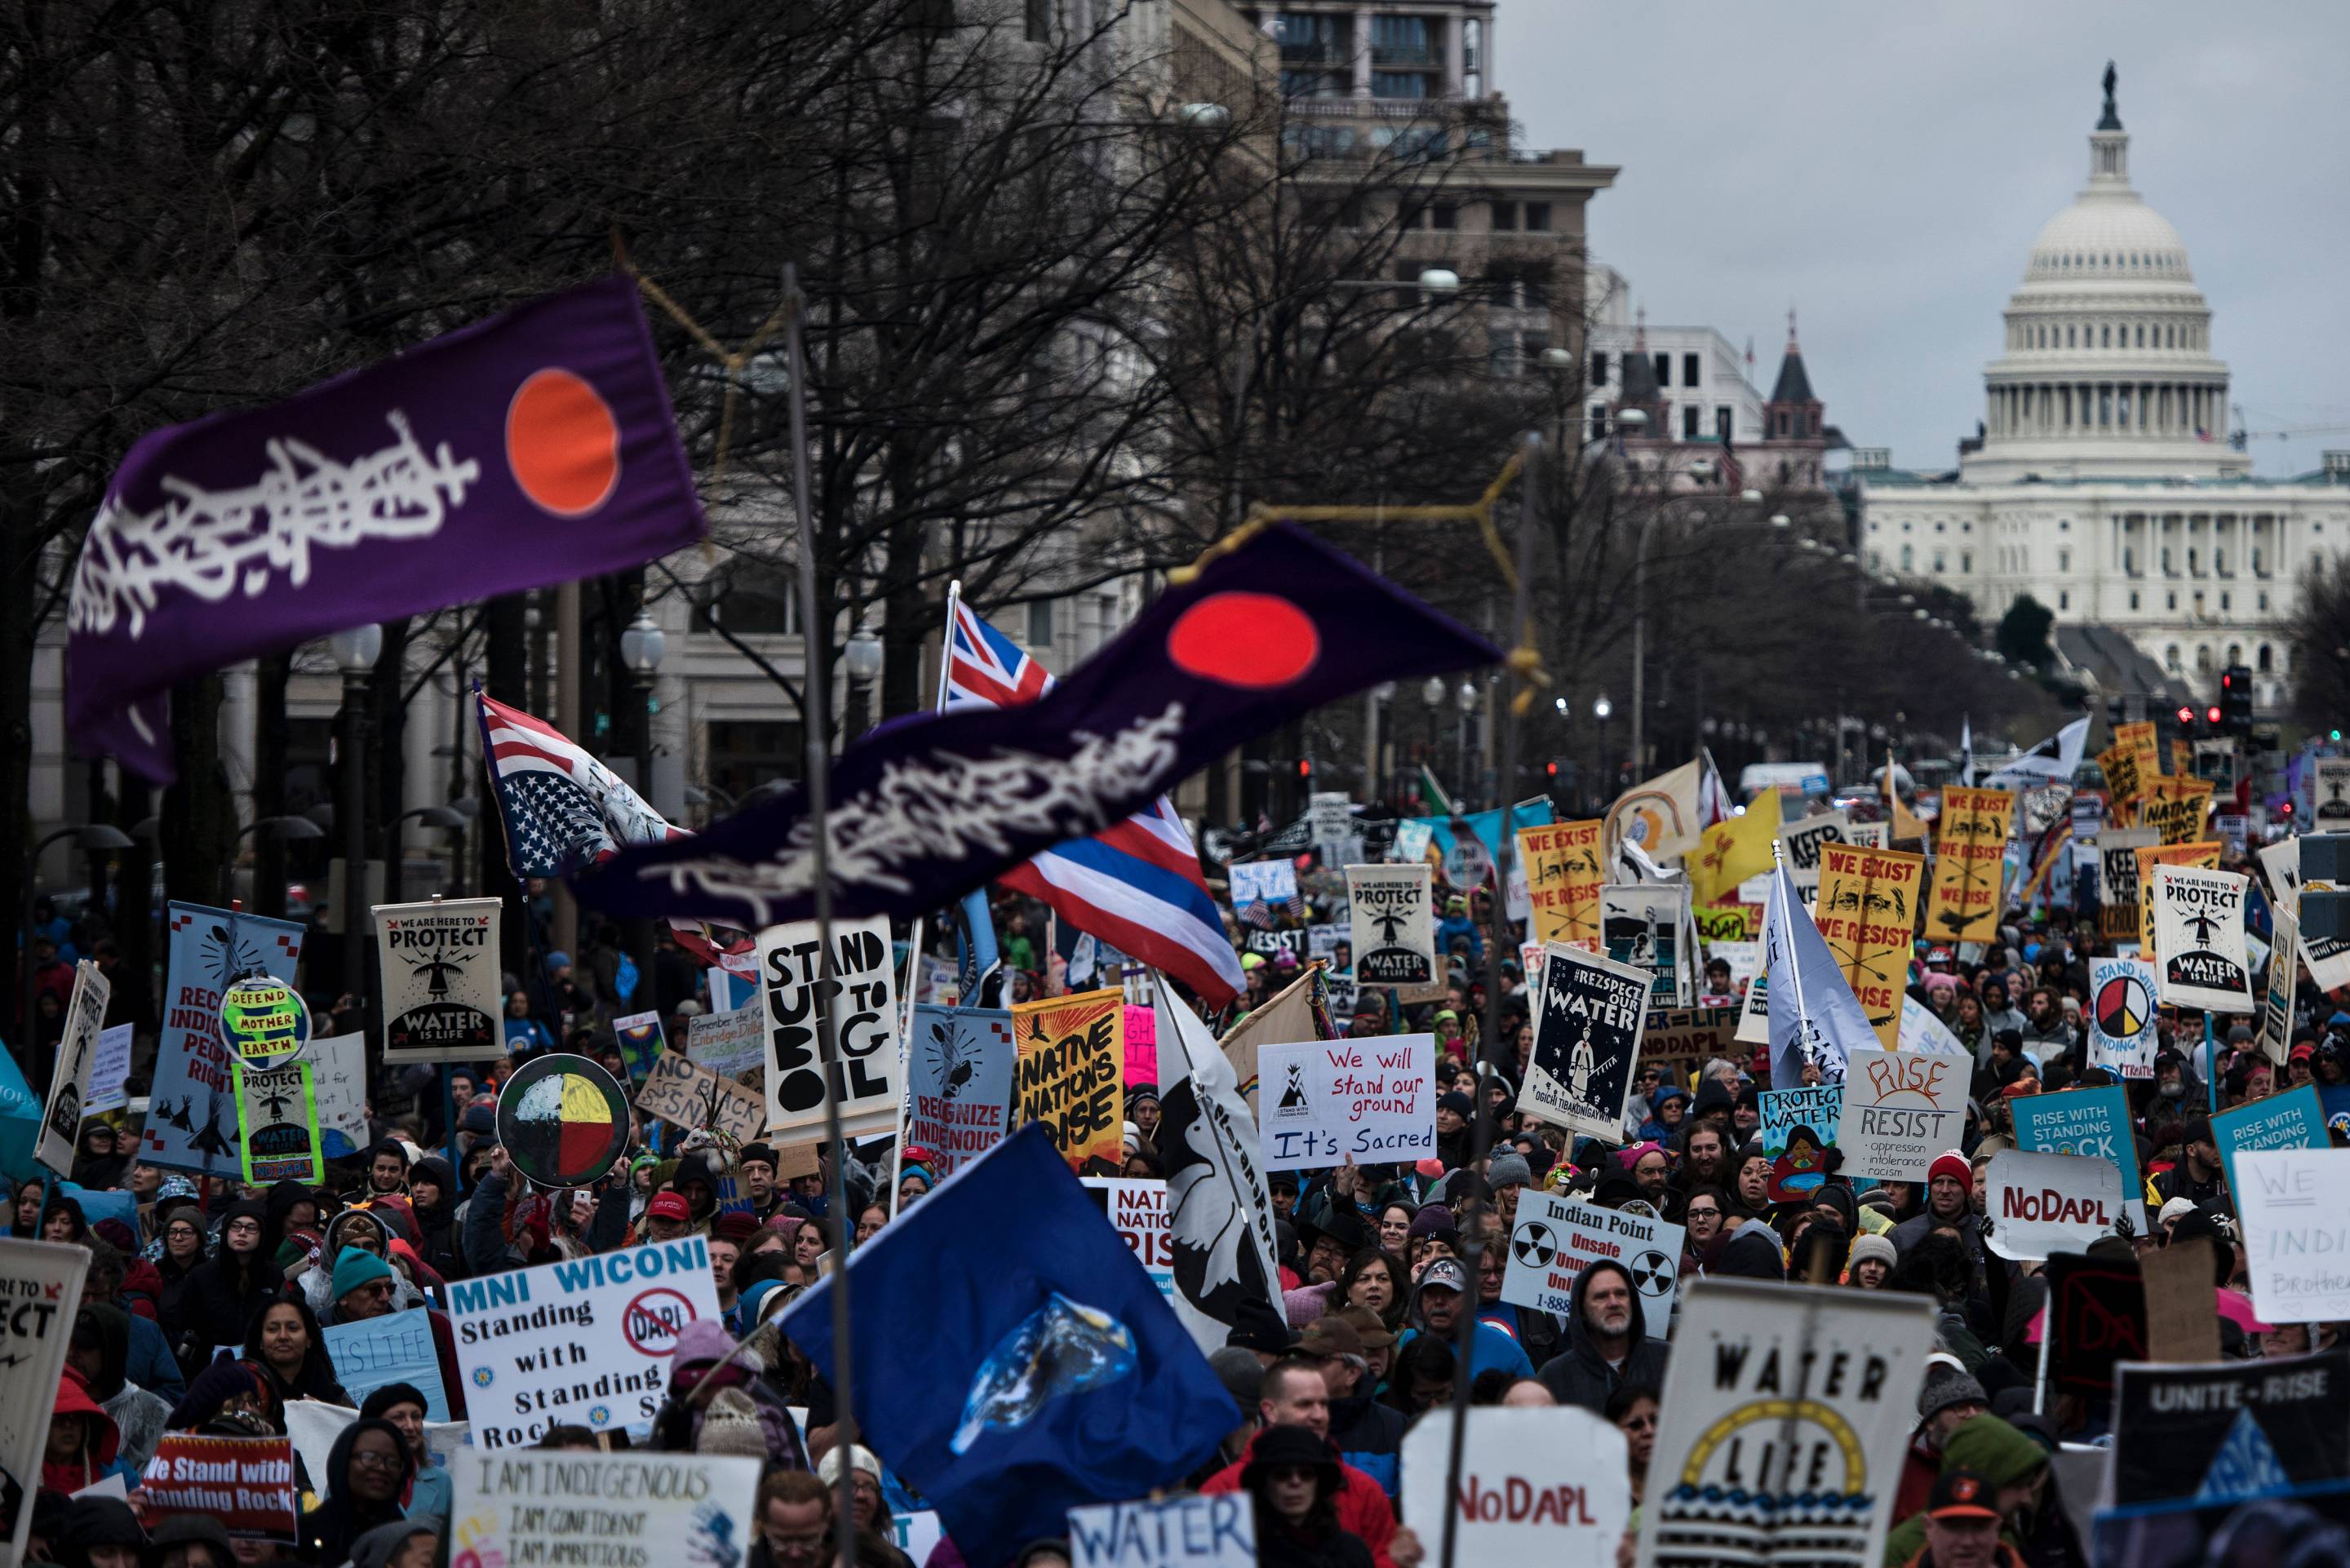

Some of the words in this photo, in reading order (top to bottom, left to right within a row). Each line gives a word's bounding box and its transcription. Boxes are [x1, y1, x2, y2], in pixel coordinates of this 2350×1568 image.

[1948, 795, 1967, 809] WE
[1971, 796, 2009, 811] EXIST
[1526, 834, 1550, 853] WE
[1554, 828, 1598, 849] EXIST
[1939, 841, 1958, 856] WE
[1962, 844, 2004, 860] RESIST
[1829, 851, 1857, 875] WE
[1860, 857, 1915, 882] EXIST
[2104, 848, 2139, 875] KEE
[1355, 890, 1421, 904] PROTECT
[1530, 889, 1555, 908] WE
[1558, 882, 1606, 905] RESIS
[1941, 888, 1961, 902] WE
[1964, 890, 1991, 904] RISE
[2166, 885, 2238, 908] PROTECT
[2202, 880, 2218, 889] HERE
[401, 919, 414, 928] WE
[417, 918, 434, 927] ARE
[437, 918, 459, 926] HERE
[463, 917, 475, 925] TO
[1816, 917, 1843, 938] WE
[1847, 922, 1912, 947] RESIST
[389, 927, 488, 948] PROTECT
[767, 930, 885, 990] STAND
[1366, 955, 1422, 970] WATER
[2177, 956, 2238, 978] WATER
[1379, 969, 1386, 977] IS
[1390, 969, 1410, 977] LIFE
[1574, 969, 1642, 999] #REZSPECT
[2095, 962, 2135, 986] STAND
[2139, 968, 2158, 999] WITH
[2191, 972, 2201, 982] IS
[2204, 972, 2224, 985] LIFE
[233, 991, 285, 1003] DEFEND
[769, 980, 844, 1025] UP
[849, 981, 887, 1012] TO
[1548, 986, 1636, 1032] WATER
[1609, 994, 1638, 1012] OUR
[241, 1015, 292, 1029] MOTHER
[402, 1012, 484, 1031] WATER
[734, 1012, 748, 1024] the
[420, 1030, 431, 1039] IS
[437, 1030, 463, 1039] LIFE
[774, 1012, 889, 1071] BIG
[244, 1040, 290, 1055] EARTH
[1022, 1013, 1115, 1091] NATIVE
[1327, 1047, 1363, 1068] We
[243, 1072, 303, 1088] PROTECT
[332, 1072, 349, 1084] for
[657, 1056, 694, 1079] NO
[1867, 1056, 1949, 1096] RISE
[778, 1058, 888, 1112] OIL
[1023, 1052, 1116, 1123] NATIONS
[1332, 1074, 1383, 1095] stand
[1392, 1078, 1423, 1094] our
[694, 1079, 760, 1123] BACK
[1350, 1095, 1414, 1122] ground
[1763, 1086, 1844, 1112] PROTECT
[1763, 1106, 1840, 1130] WATER
[1861, 1110, 1945, 1138] RESIST
[2032, 1111, 2064, 1126] RISE
[2068, 1105, 2108, 1122] WITH
[2232, 1123, 2264, 1141] RISE
[2265, 1108, 2303, 1129] WITH
[257, 1127, 308, 1143] WATER
[1274, 1130, 1338, 1159] It's
[1351, 1125, 1433, 1153] Sacred
[2033, 1121, 2111, 1141] STANDING
[1869, 1155, 1927, 1167] intolerance
[1870, 1143, 1926, 1156] oppression
[257, 1166, 274, 1176] NO
[277, 1161, 307, 1176] DAPL
[1867, 1167, 1903, 1177] racism
[2254, 1159, 2315, 1194] WE
[1118, 1189, 1166, 1210] NAT
[1547, 1201, 1603, 1229] Indian
[1608, 1216, 1655, 1242] Point
[1572, 1233, 1621, 1257] Unsafe
[555, 1238, 707, 1293] WICONI
[20, 1280, 39, 1297] TO
[451, 1272, 529, 1315] MNI
[461, 1300, 594, 1344] Standing
[330, 1337, 365, 1377] IS
[367, 1328, 429, 1371] LIFE
[515, 1342, 587, 1373] with
[1714, 1344, 1886, 1401] WATER
[515, 1364, 662, 1415] Standing
[173, 1456, 237, 1482] Stand
[241, 1458, 291, 1483] with
[1725, 1438, 1829, 1490] LIFE
[498, 1460, 532, 1495] AM
[541, 1462, 711, 1499] INDIGENOUS
[145, 1486, 233, 1513] tanding
[237, 1487, 292, 1513] Rock
[520, 1508, 545, 1534] AM
[548, 1513, 647, 1537] CONFIDENT
[1068, 1496, 1262, 1564] WATER
[520, 1539, 544, 1566] AM
[549, 1540, 647, 1568] AMBITIOUS
